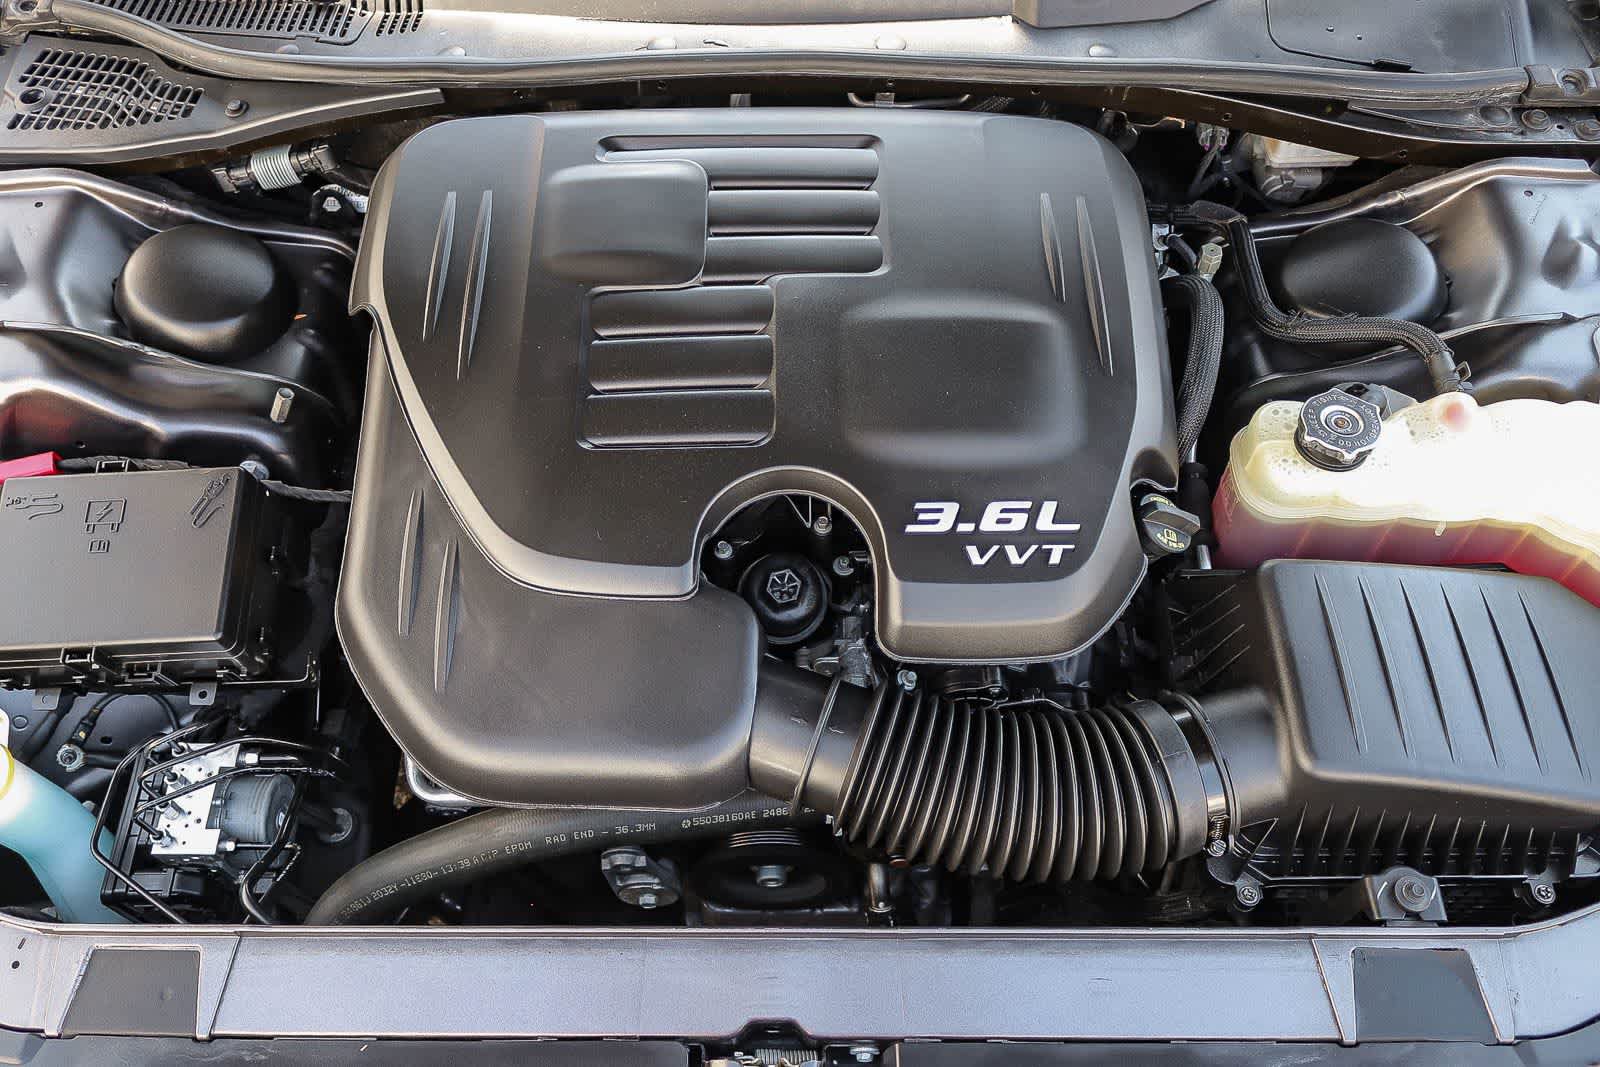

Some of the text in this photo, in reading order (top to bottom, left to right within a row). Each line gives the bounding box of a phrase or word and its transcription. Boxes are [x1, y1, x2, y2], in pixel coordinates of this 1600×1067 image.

[904, 500, 1081, 535] 3.6L
[963, 543, 1076, 567] VVT
[574, 829, 594, 840] END
[615, 823, 656, 835] 36.3MM
